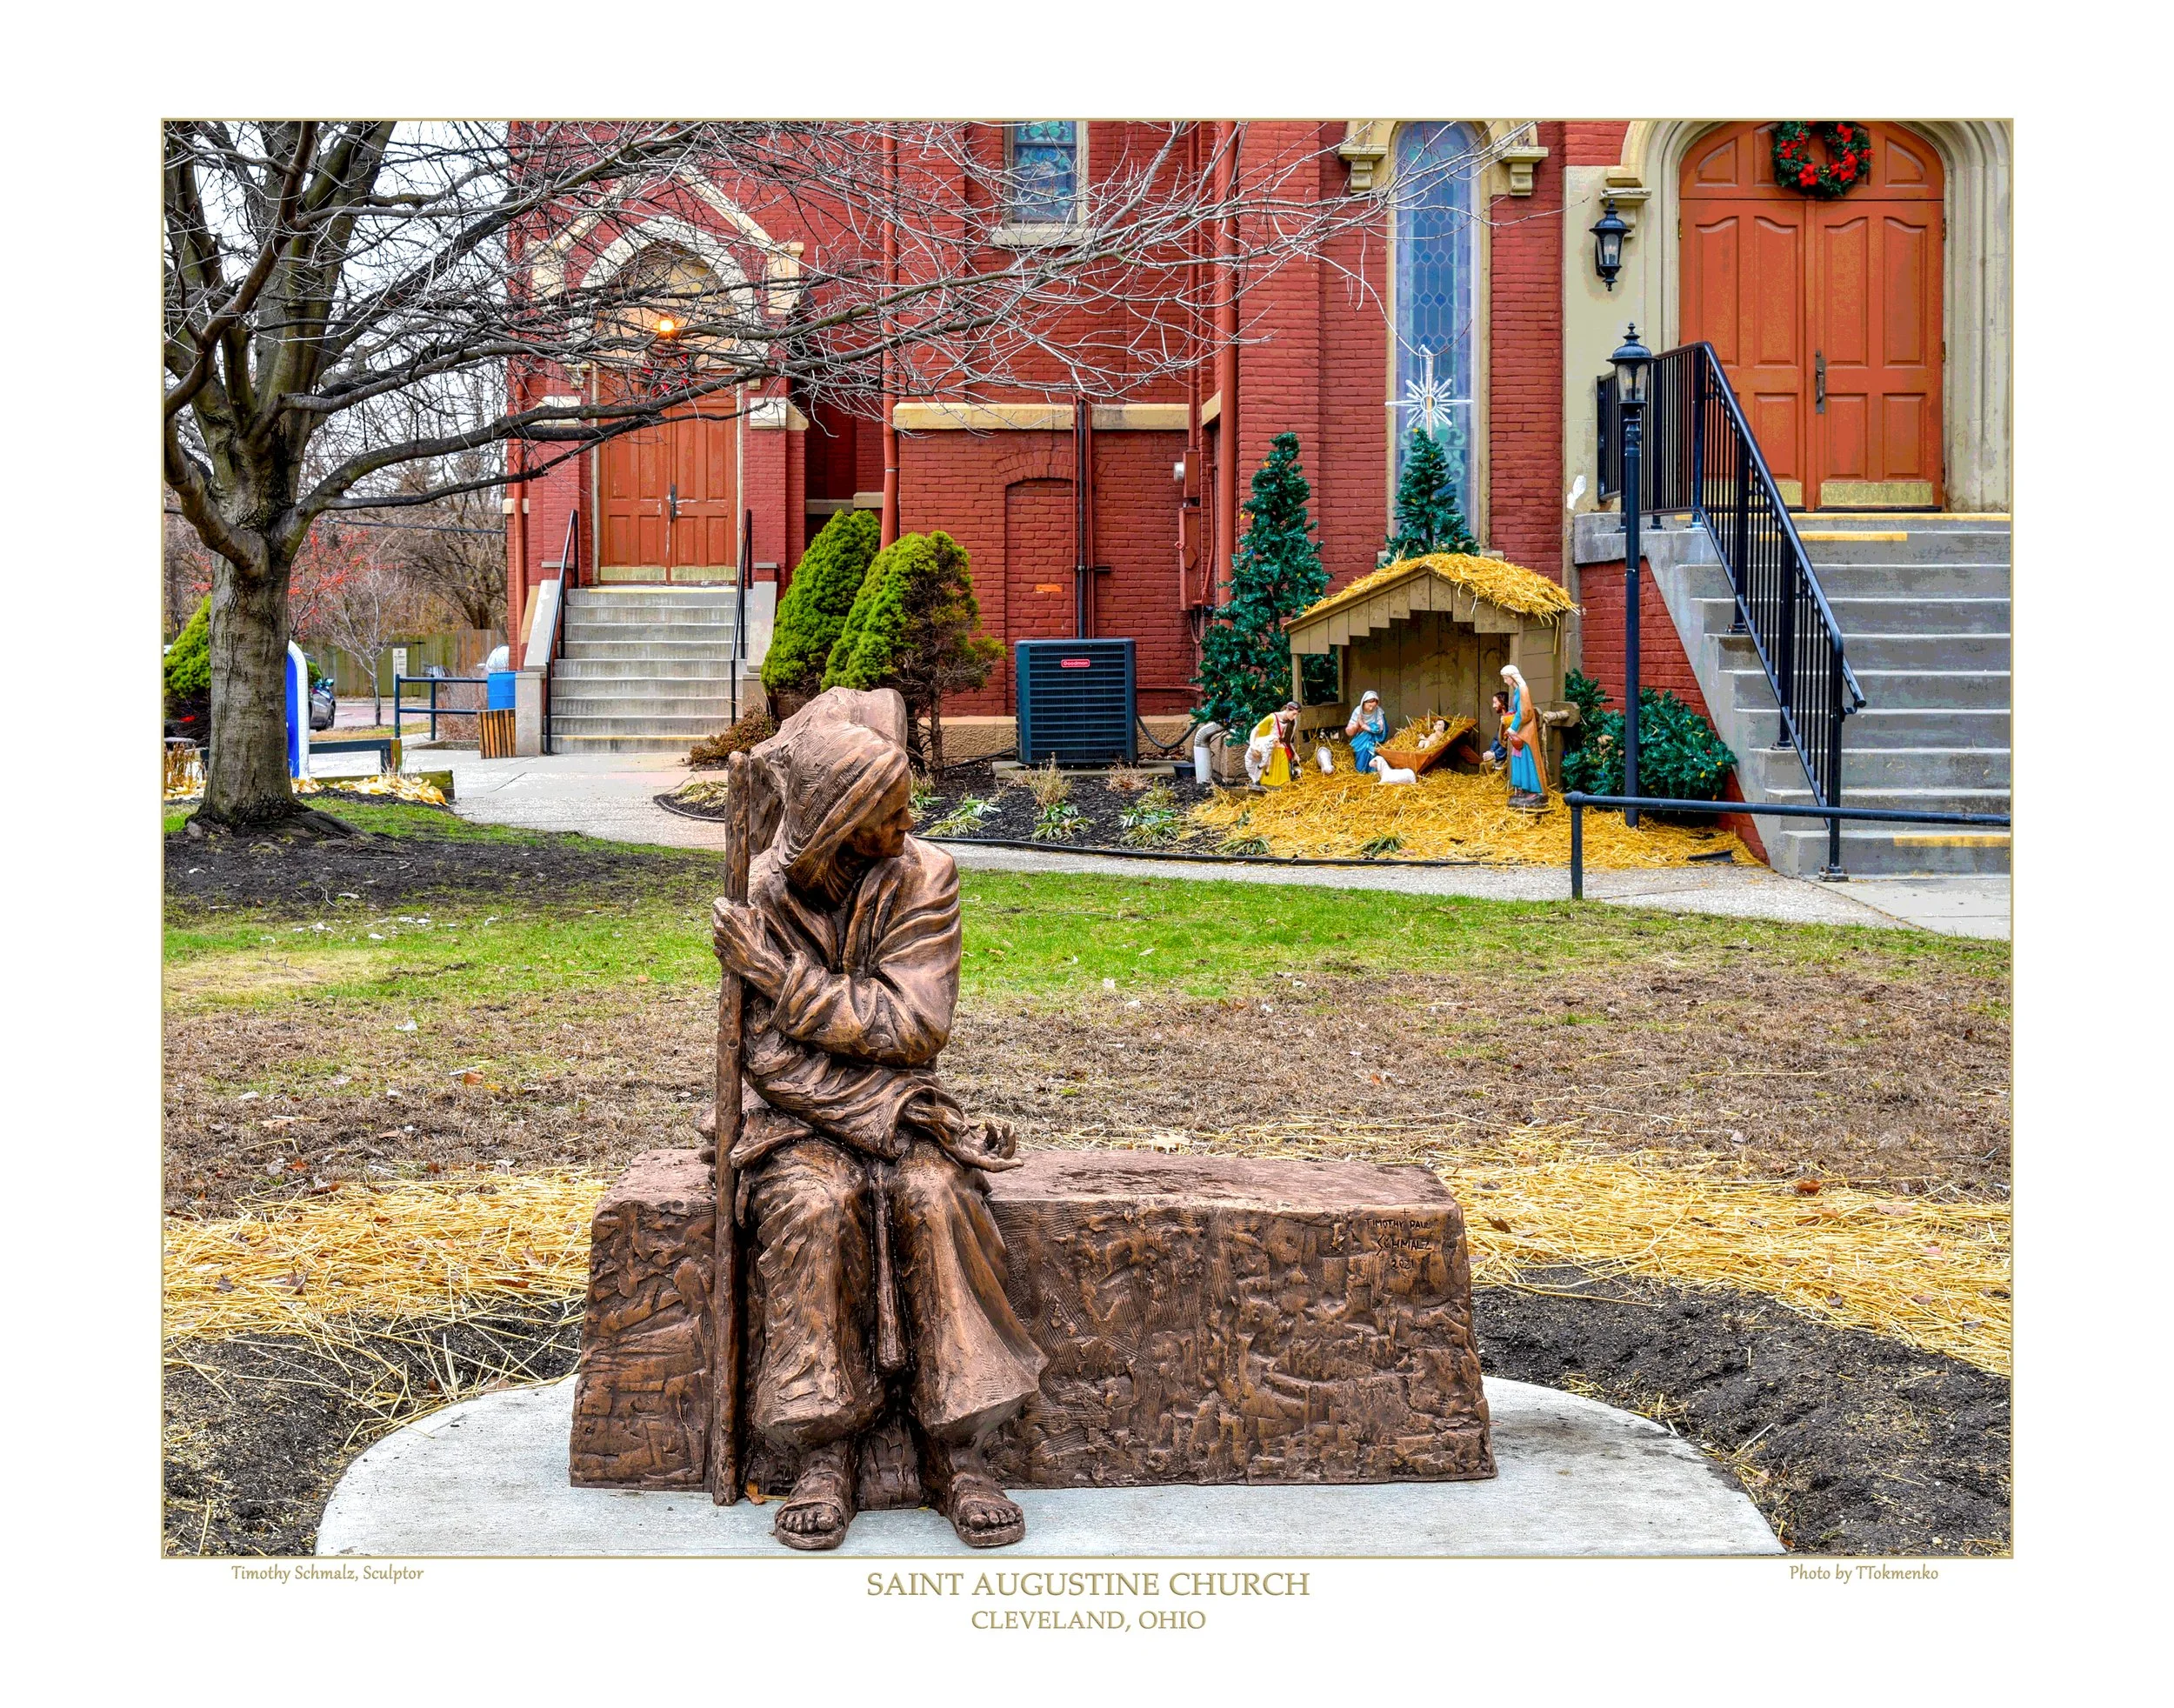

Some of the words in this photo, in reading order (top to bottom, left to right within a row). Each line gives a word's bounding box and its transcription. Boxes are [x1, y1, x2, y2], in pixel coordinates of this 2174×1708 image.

[1364, 1218, 1404, 1229] TIMOTHY
[1376, 1234, 1432, 1256] SCHMALZ
[1391, 1259, 1414, 1270] 2021
